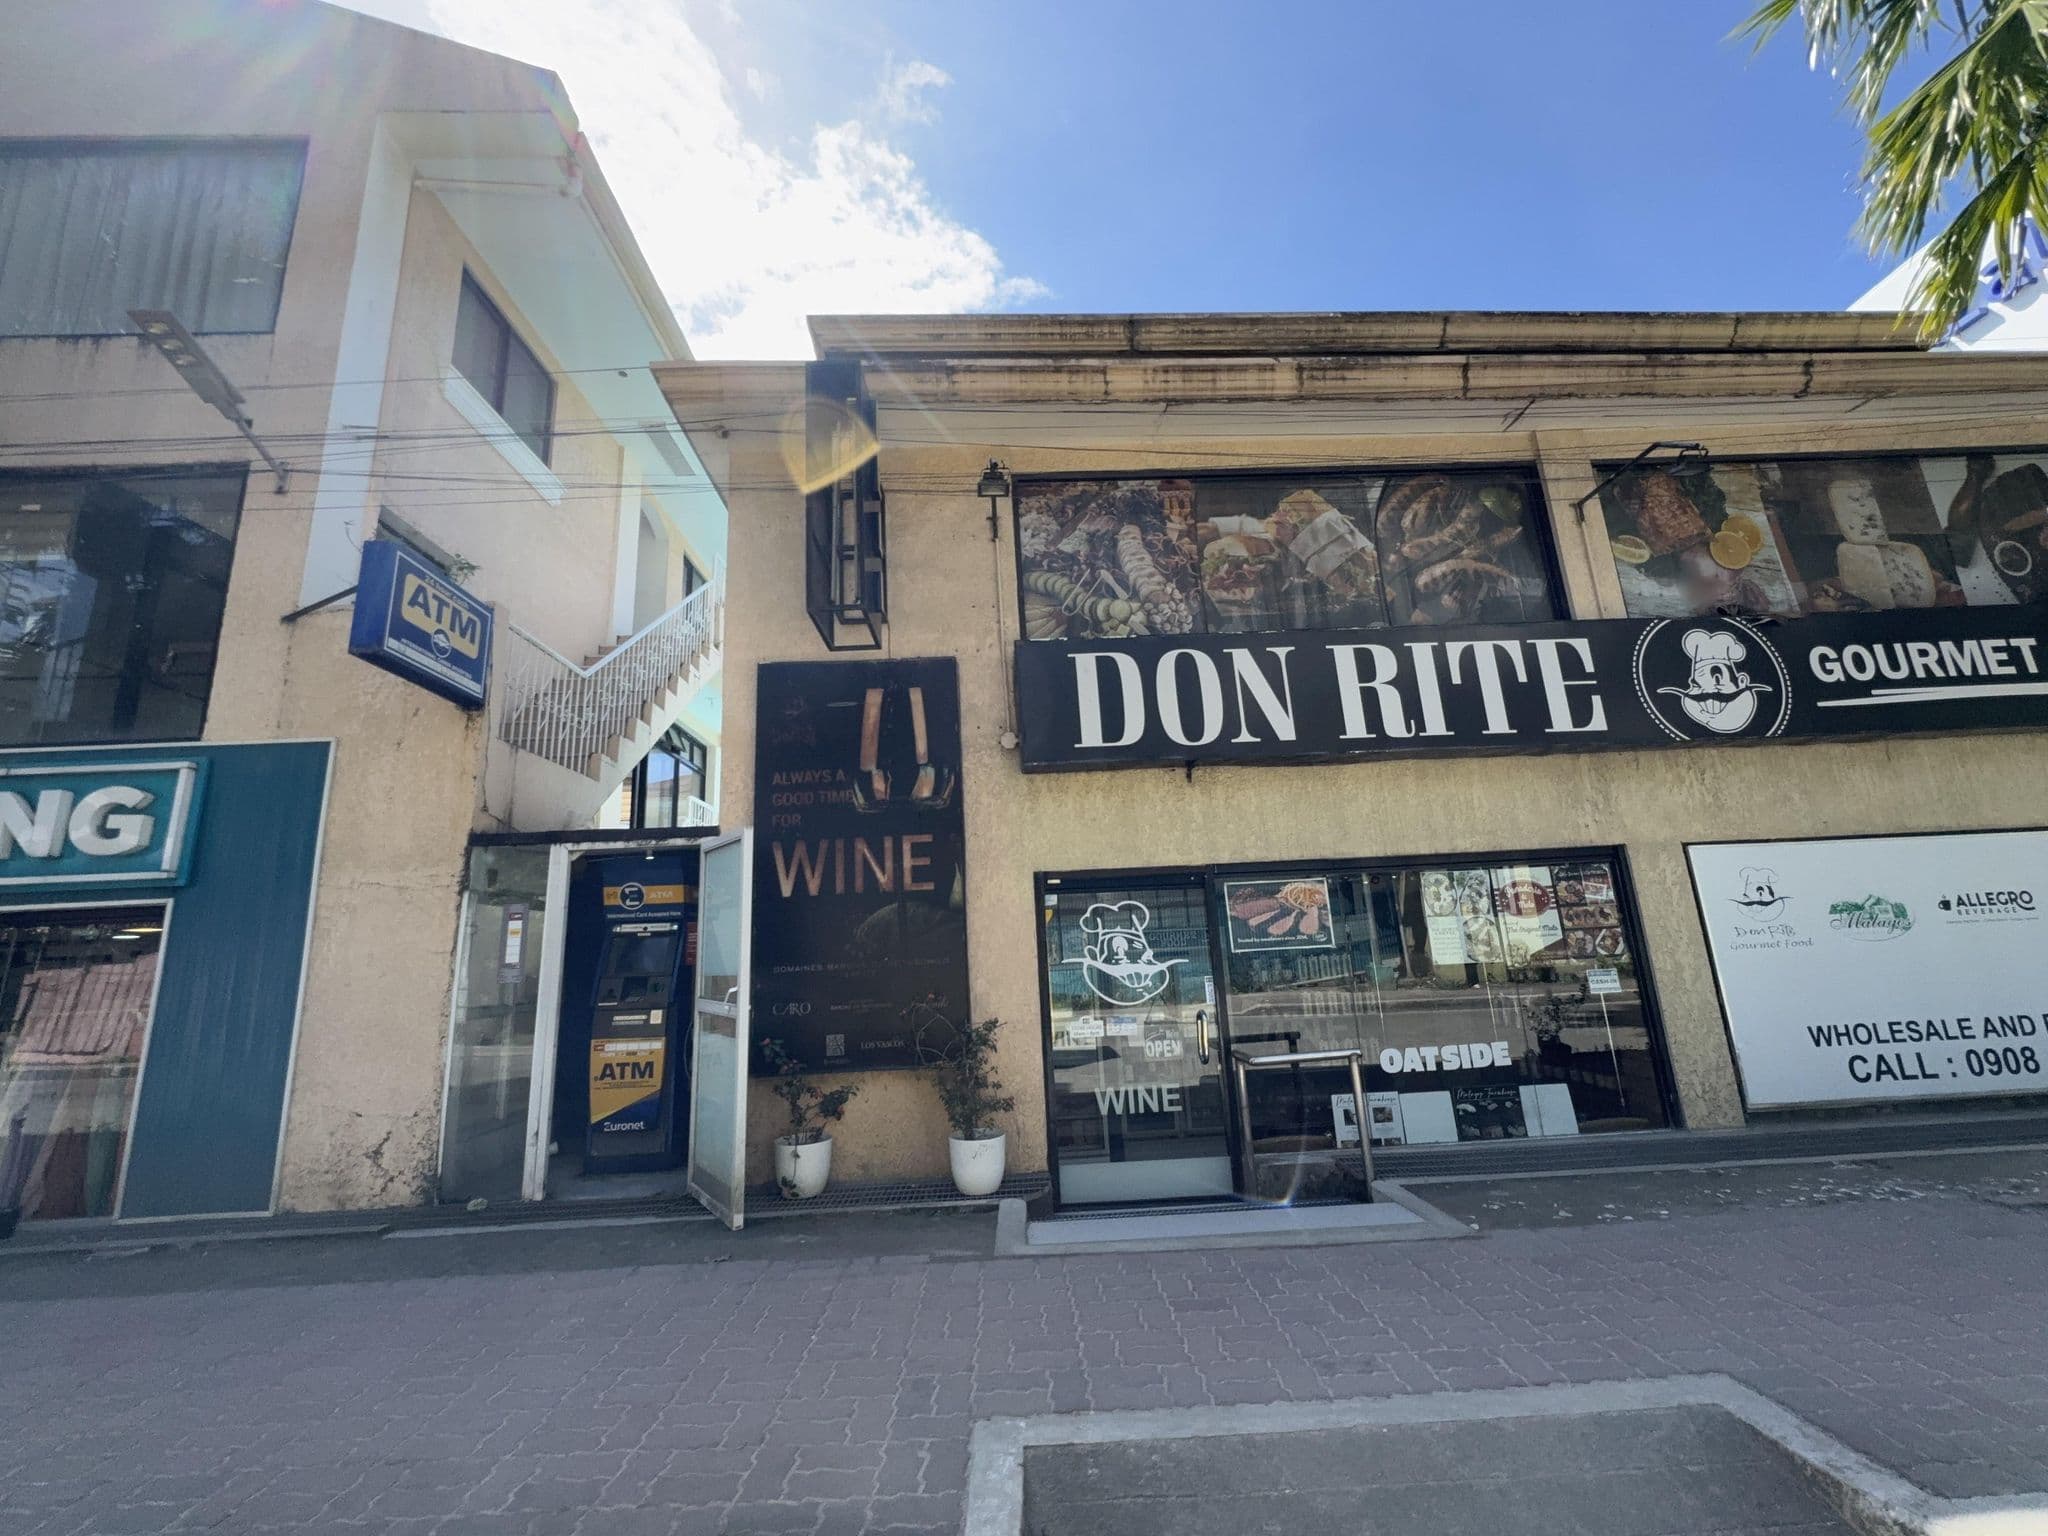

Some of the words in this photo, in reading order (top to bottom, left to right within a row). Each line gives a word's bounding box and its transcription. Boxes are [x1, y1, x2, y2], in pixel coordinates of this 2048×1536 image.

[407, 584, 477, 645] ATM
[1809, 637, 2039, 683] GOURMET
[1067, 646, 1296, 748] DON
[1325, 638, 1608, 739] RITE
[772, 769, 832, 785] ALWAYS
[836, 769, 846, 782] A
[772, 791, 814, 806] GOOD
[772, 813, 802, 827] FOR
[772, 834, 935, 898] WINE
[1956, 890, 2036, 911] ALLEGRO
[1956, 907, 2018, 916] BEVERAGE
[1807, 1017, 1976, 1047] WHOLESALE
[1983, 1014, 2037, 1039] AND
[1145, 1040, 1183, 1058] OPEN
[1380, 1041, 1512, 1074] OATSIDE
[1848, 1051, 1940, 1083] CALL
[1965, 1046, 2041, 1077] 0908
[599, 1060, 654, 1081] ATM
[1094, 1083, 1183, 1115] WINE
